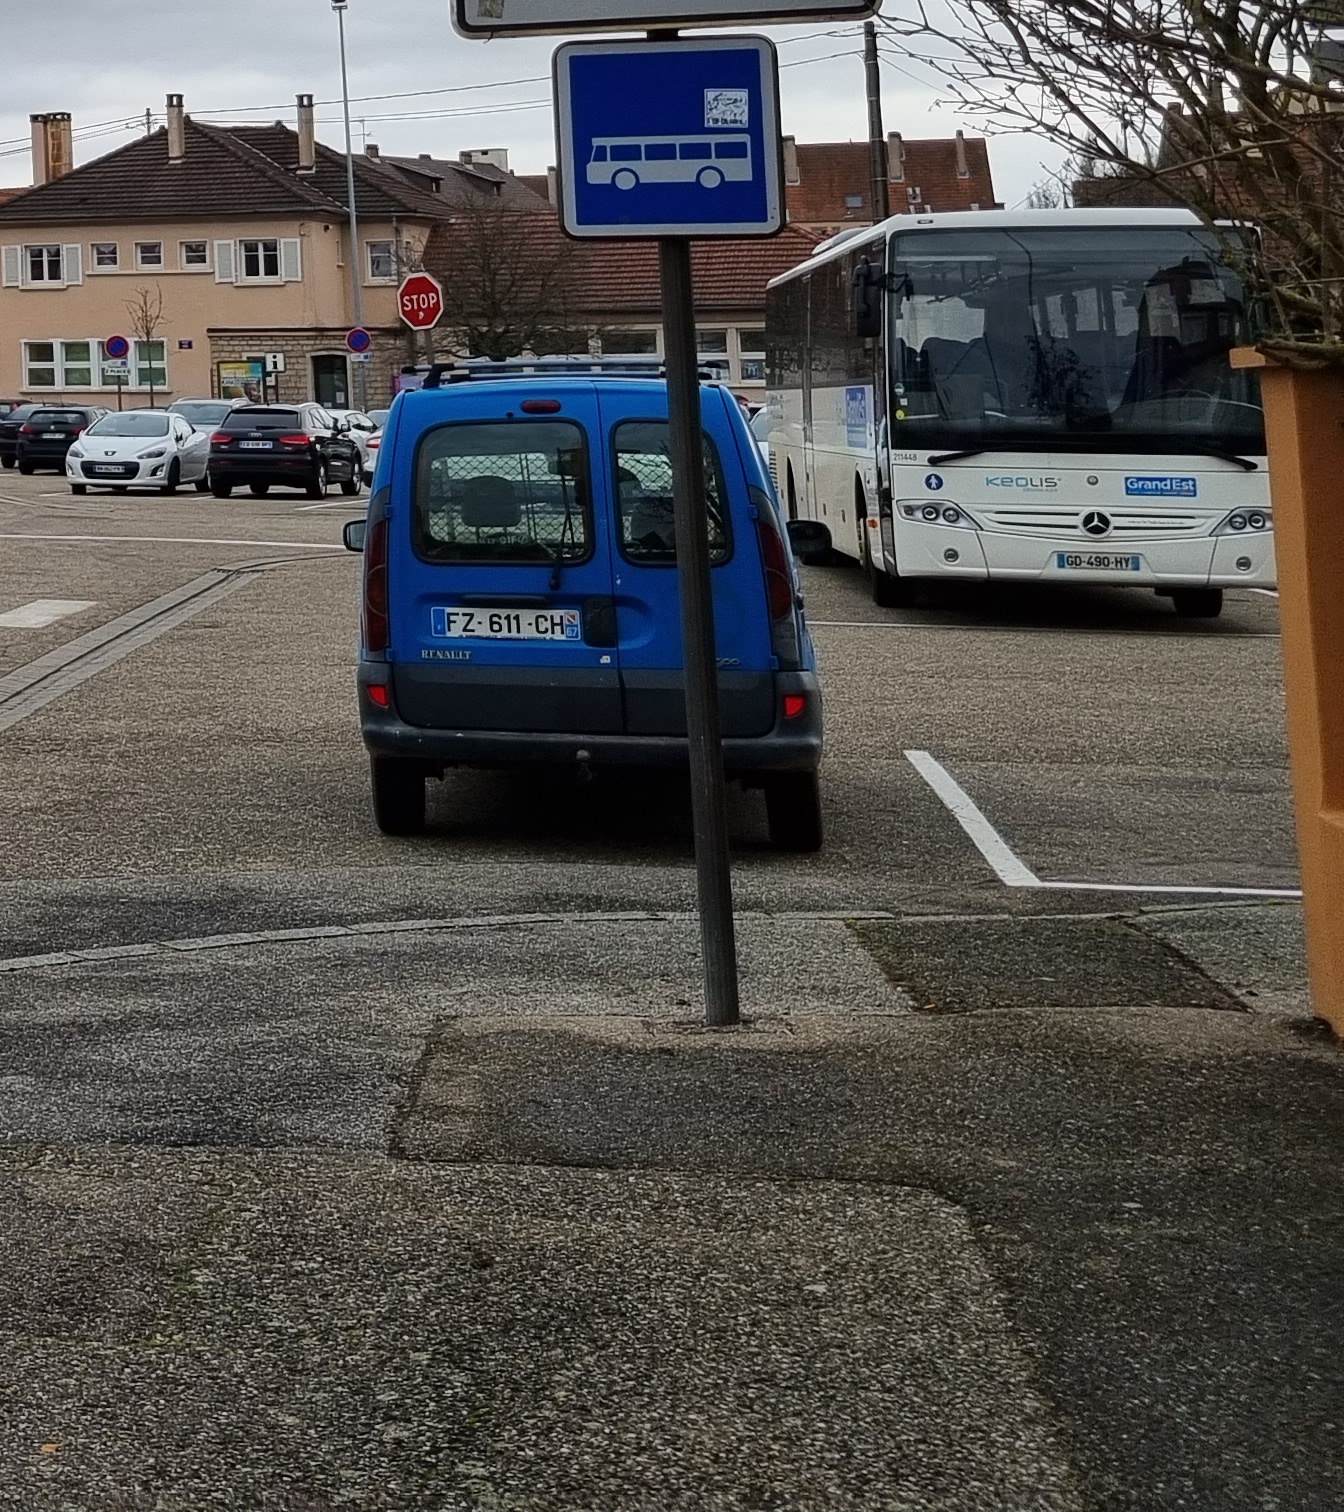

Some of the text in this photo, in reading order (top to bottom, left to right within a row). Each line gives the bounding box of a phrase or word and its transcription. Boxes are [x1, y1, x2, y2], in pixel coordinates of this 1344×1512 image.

[402, 292, 438, 311] STOP
[1126, 478, 1195, 491] Grand Est
[1066, 555, 1130, 568] GD-490-HY
[421, 649, 471, 659] RENAULT
